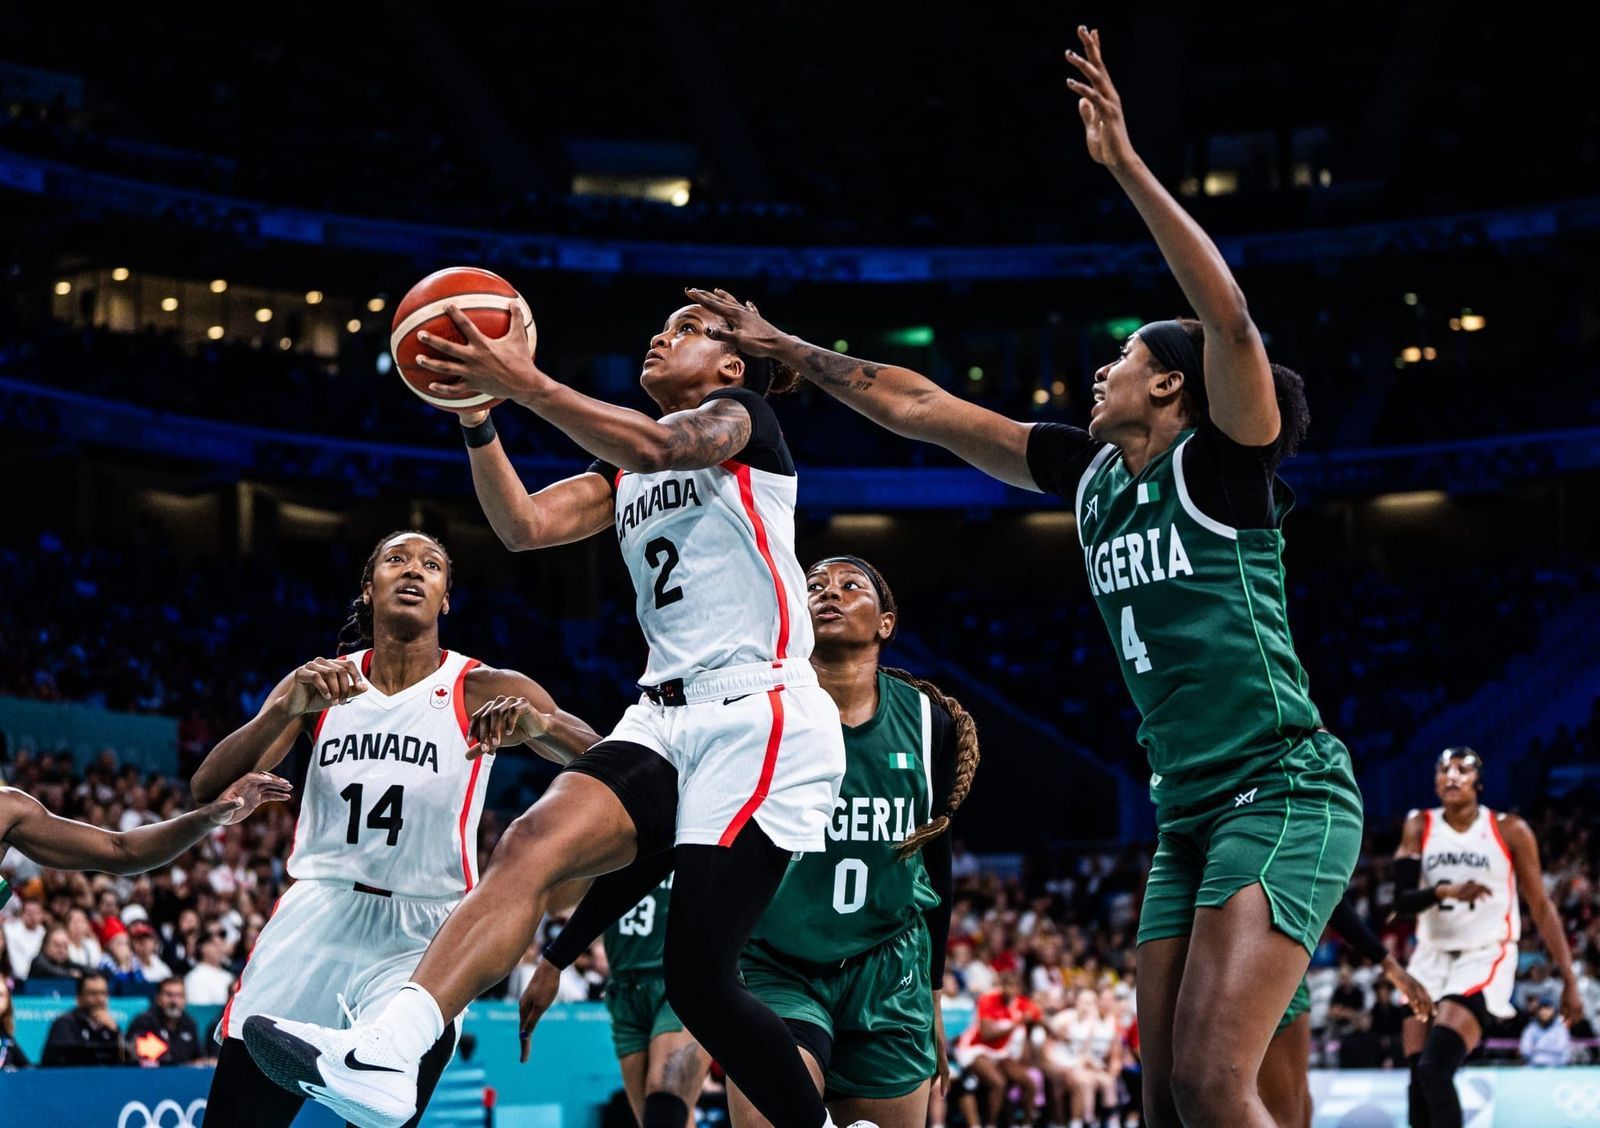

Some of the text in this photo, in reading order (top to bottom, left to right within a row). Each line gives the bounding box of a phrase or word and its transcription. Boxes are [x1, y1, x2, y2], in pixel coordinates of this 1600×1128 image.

[617, 478, 702, 544] ANADA
[644, 536, 684, 610] 2
[1084, 523, 1193, 596] IGERIA
[1121, 605, 1152, 674] 4
[319, 732, 438, 774] CANADA
[340, 783, 404, 846] 14
[826, 797, 915, 841] GERIA
[832, 858, 868, 914] 0
[1428, 851, 1490, 872] CANADA
